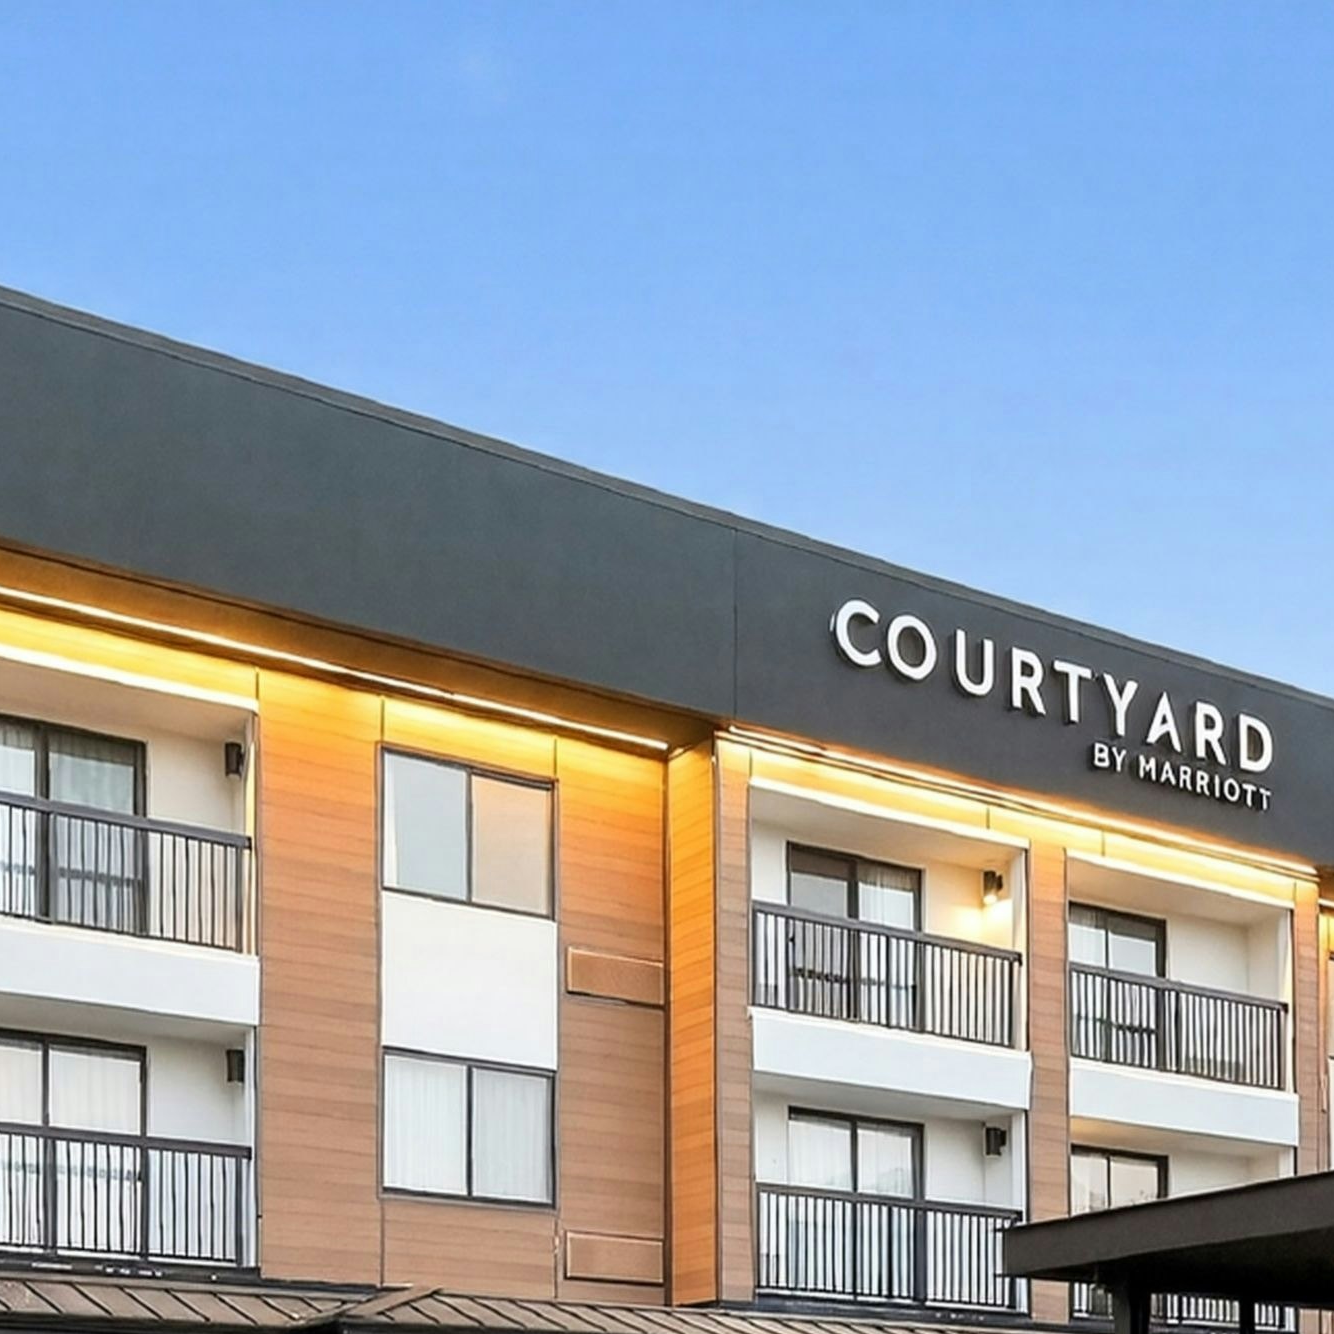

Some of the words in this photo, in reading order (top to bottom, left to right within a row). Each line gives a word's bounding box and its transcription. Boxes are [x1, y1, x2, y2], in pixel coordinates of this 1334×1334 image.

[834, 599, 1273, 773] COURTYARD
[1093, 742, 1127, 773] BY
[1138, 754, 1272, 811] MARRIOTT
